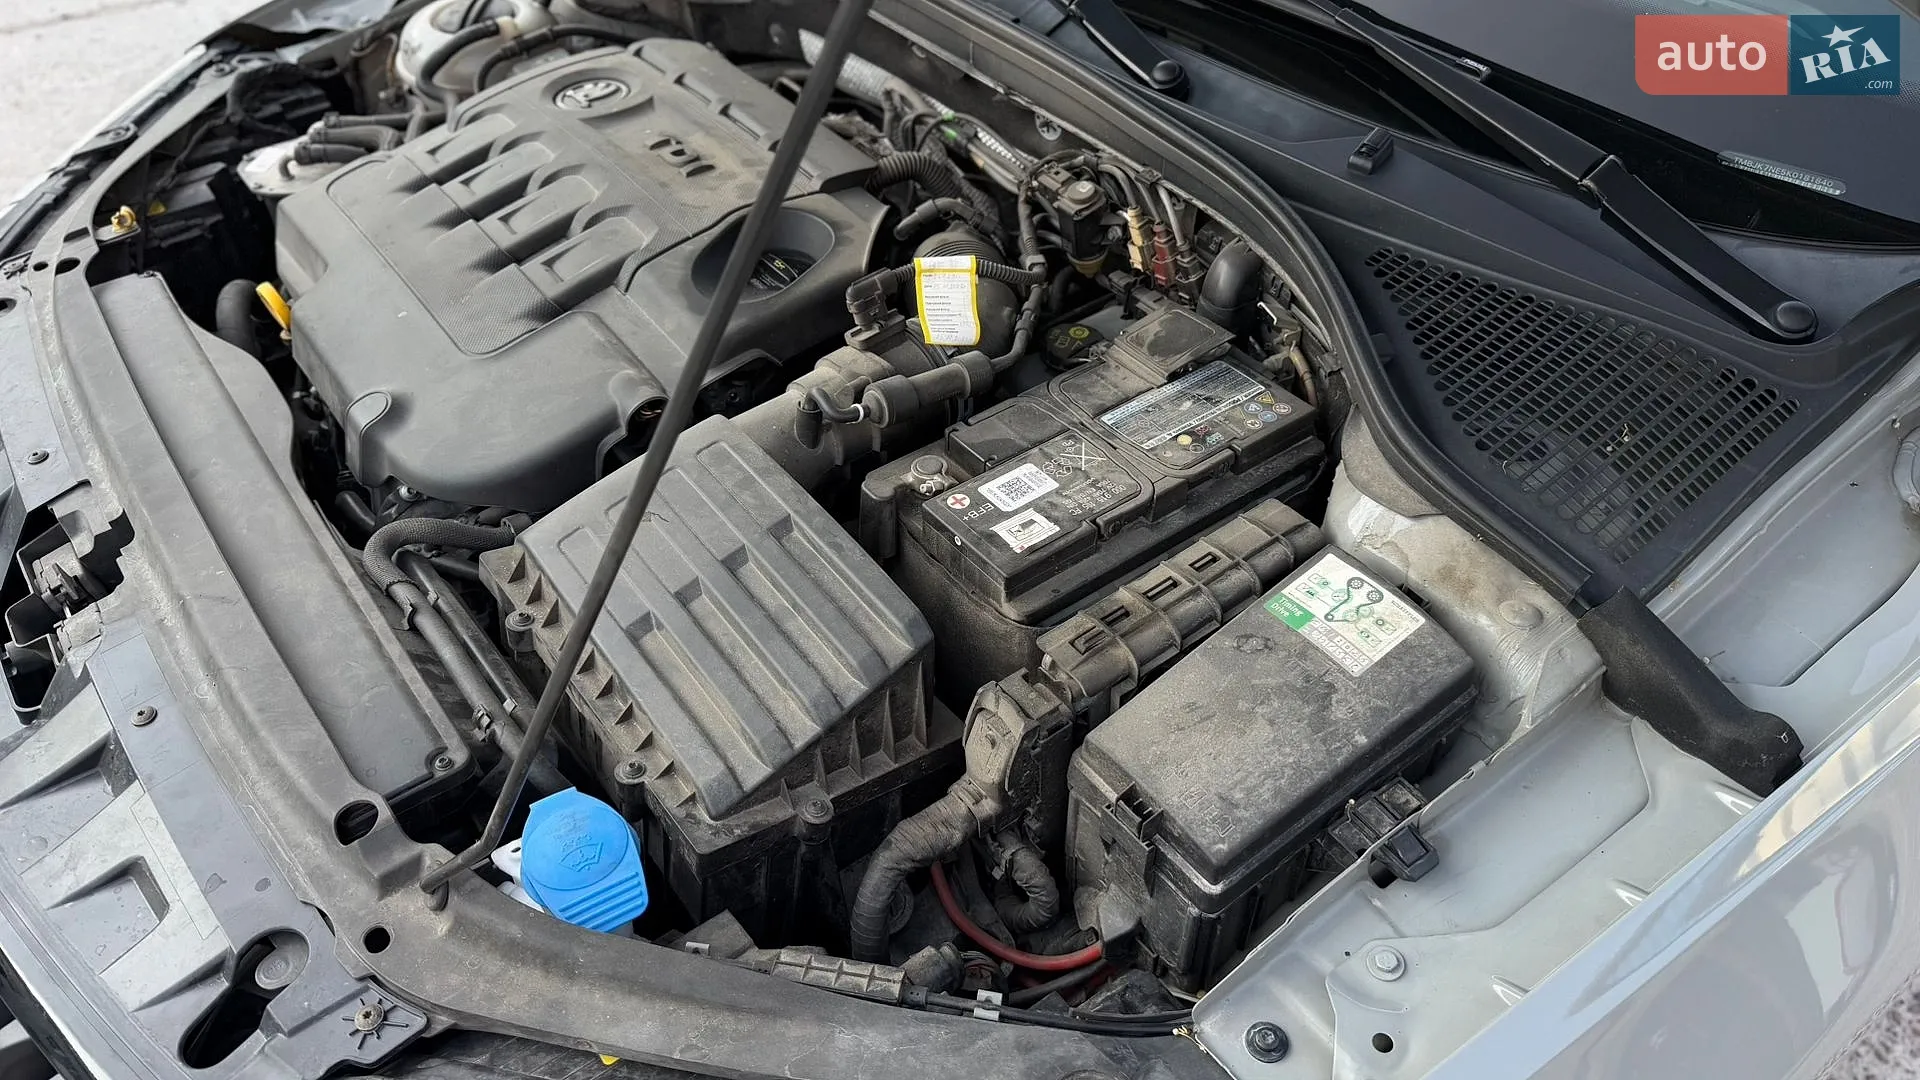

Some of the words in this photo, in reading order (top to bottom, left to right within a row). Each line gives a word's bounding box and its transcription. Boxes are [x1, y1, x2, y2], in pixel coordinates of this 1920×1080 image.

[963, 502, 995, 520] EFB+
[1271, 602, 1290, 617] Drive
[1280, 596, 1304, 617] Timing
